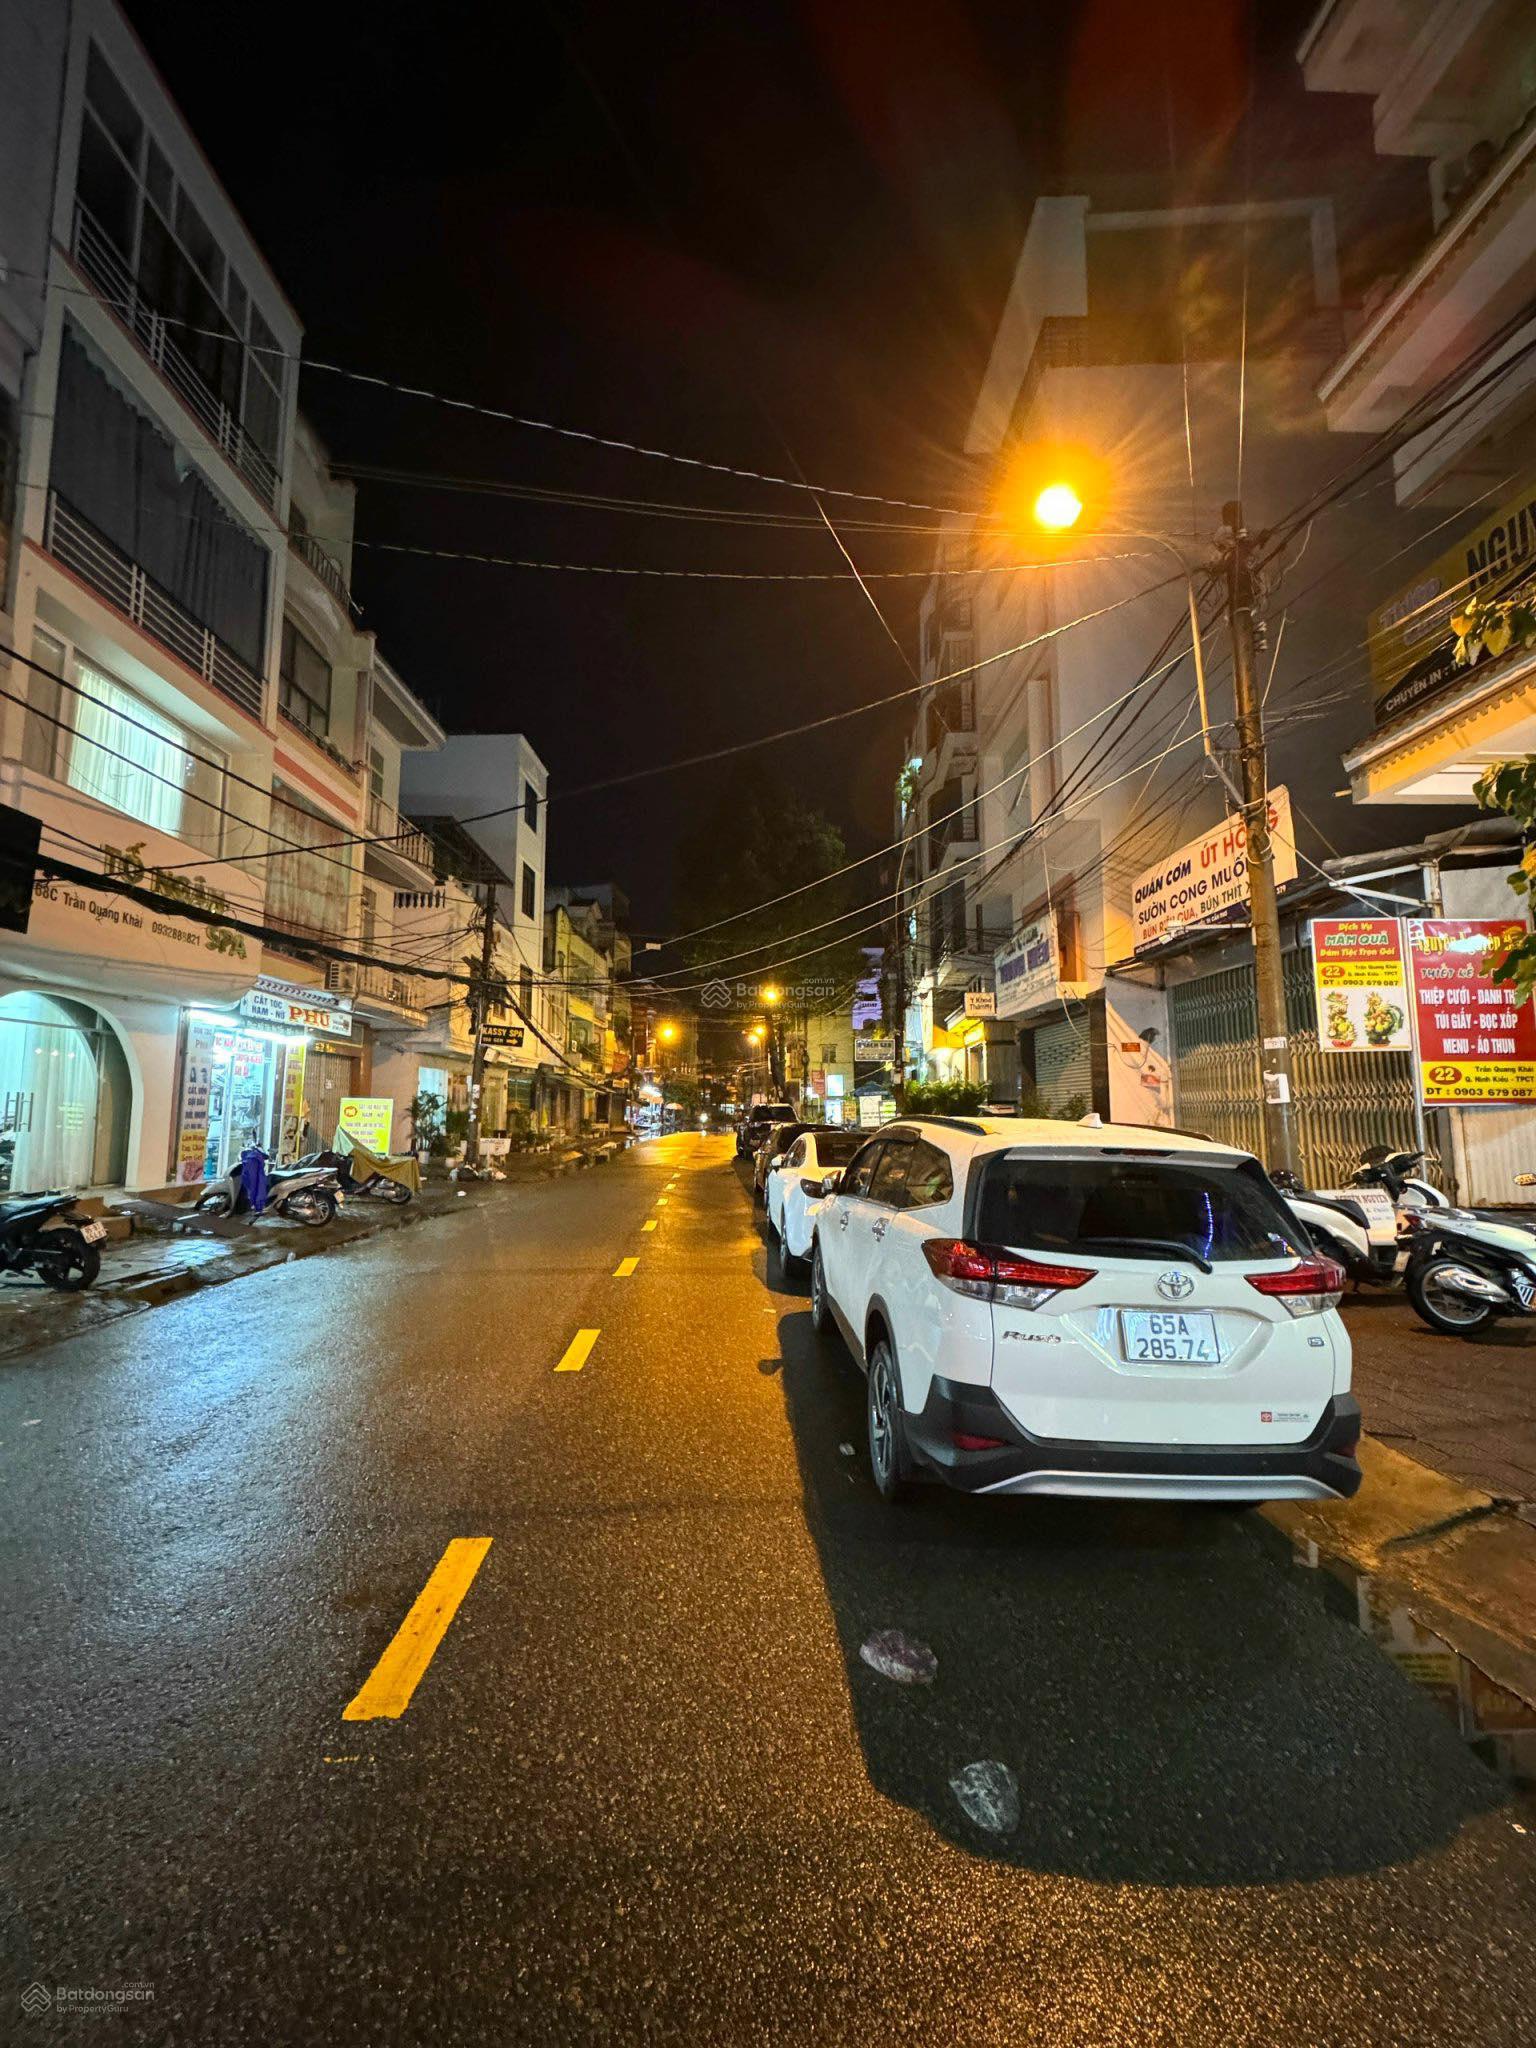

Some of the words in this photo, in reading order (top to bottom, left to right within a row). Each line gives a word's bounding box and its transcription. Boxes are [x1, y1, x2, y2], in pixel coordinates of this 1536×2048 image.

[205, 924, 248, 960] SPA
[1325, 966, 1341, 977] 22
[1477, 988, 1503, 1005] DANH
[1442, 1038, 1470, 1055] MENU
[1477, 1034, 1490, 1054] ÁO
[1491, 1038, 1516, 1055] THUN
[1434, 1066, 1456, 1082] 22
[1454, 1087, 1484, 1096] 0903
[1487, 1088, 1510, 1096] 679
[1511, 1088, 1534, 1097] 087
[1149, 1314, 1190, 1336] 65A
